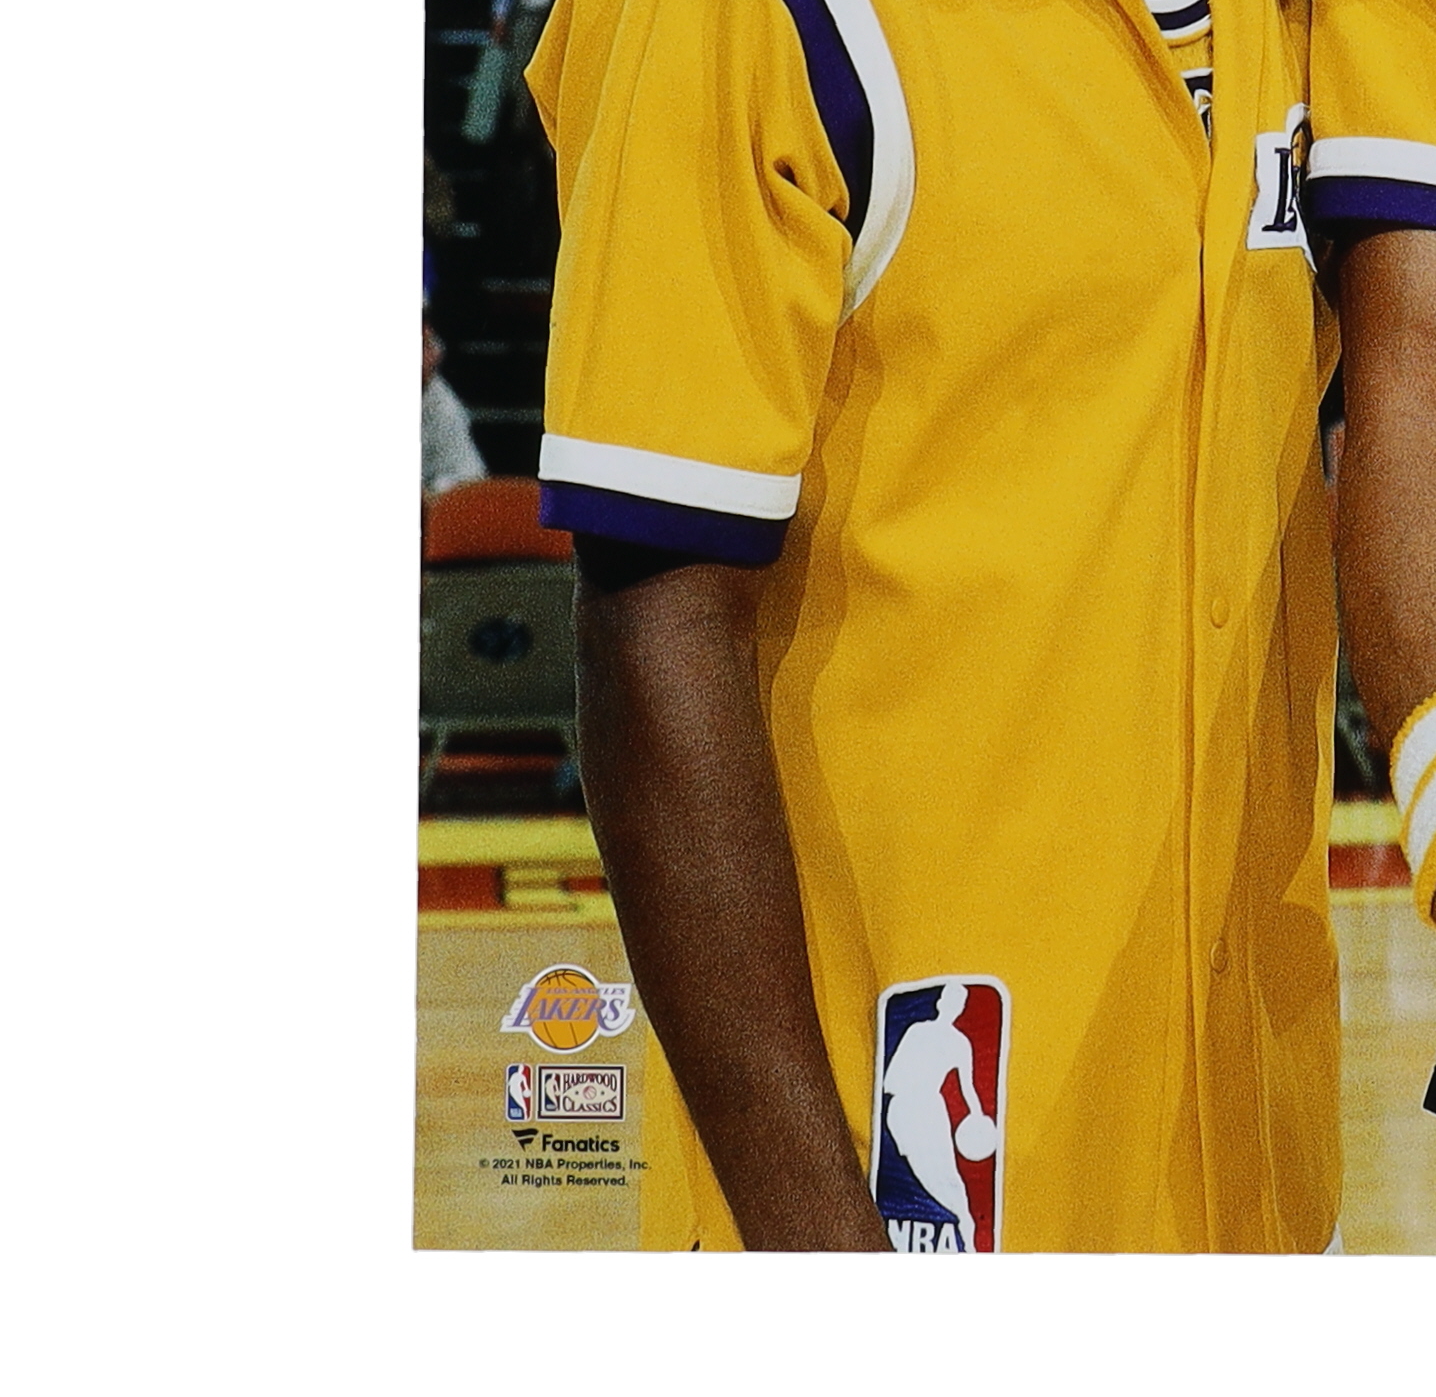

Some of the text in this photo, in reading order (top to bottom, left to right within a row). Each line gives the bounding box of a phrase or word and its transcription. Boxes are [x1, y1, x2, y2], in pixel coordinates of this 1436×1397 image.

[507, 987, 630, 1031] LAKERS
[563, 1073, 617, 1092] HARDWOOD
[563, 1095, 617, 1113] CLASSICS
[542, 1134, 620, 1152] Fanatics
[492, 1159, 520, 1169] 2021
[525, 1159, 553, 1169] NBA
[501, 1175, 518, 1186] All
[522, 1175, 562, 1188] Rights
